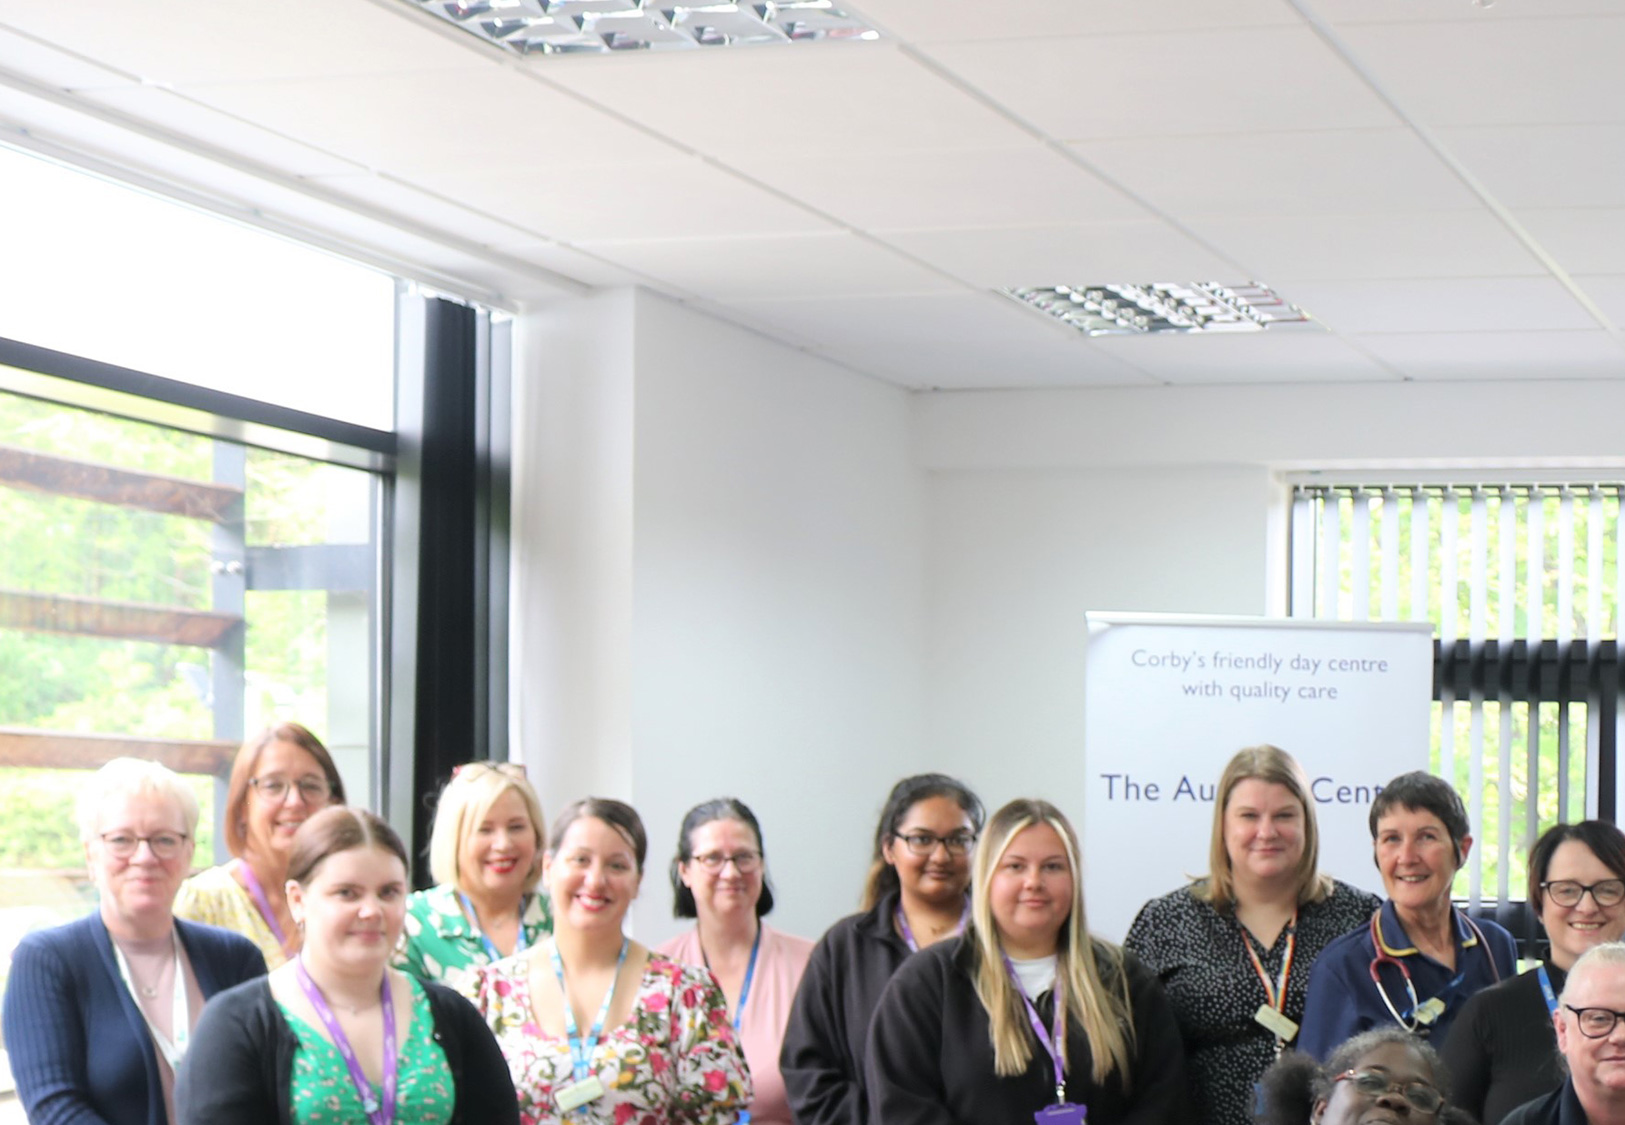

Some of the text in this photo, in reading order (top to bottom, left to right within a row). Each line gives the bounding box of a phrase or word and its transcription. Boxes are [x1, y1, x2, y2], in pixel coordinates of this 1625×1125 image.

[1131, 649, 1388, 675] Corby's friendly day centre
[1182, 680, 1338, 703] with quality care
[1100, 774, 1160, 801] The
[1311, 777, 1384, 804] Cent
